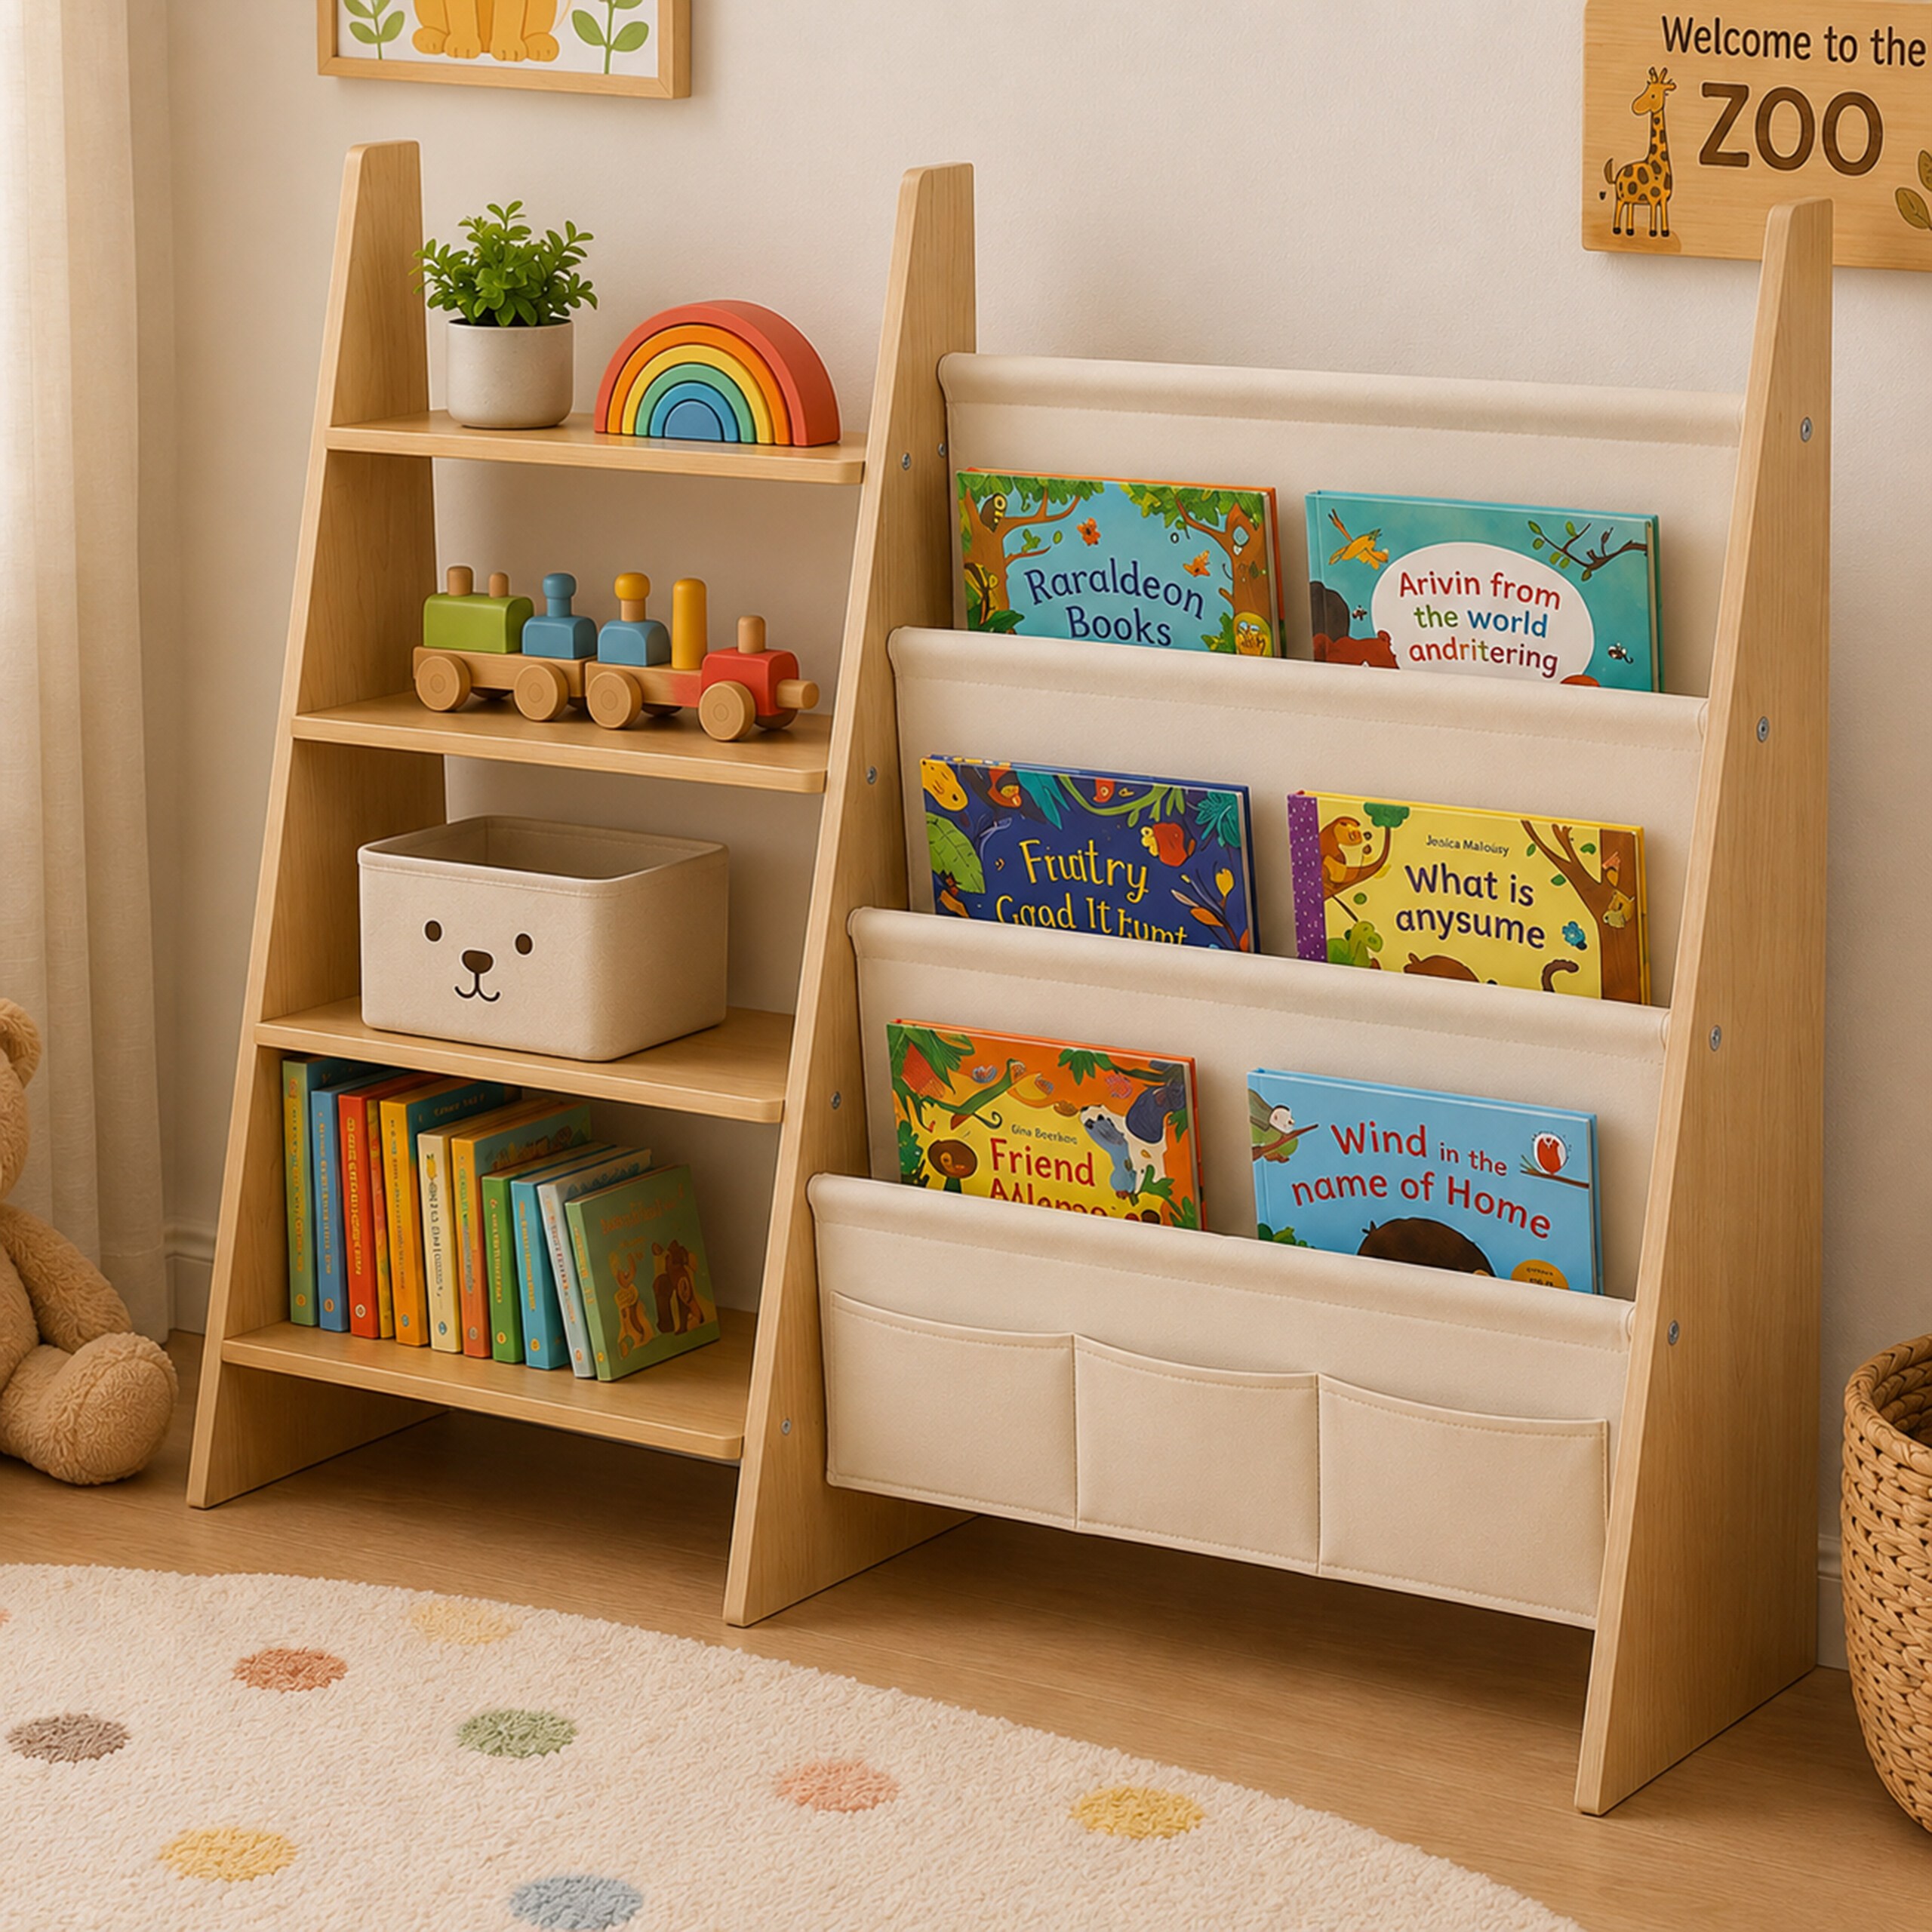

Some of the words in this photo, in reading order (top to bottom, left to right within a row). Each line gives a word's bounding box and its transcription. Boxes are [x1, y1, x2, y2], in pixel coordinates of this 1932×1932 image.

[1662, 15, 1811, 60] Welcome
[1823, 26, 1858, 63] to
[1870, 26, 1926, 66] the
[1699, 82, 1884, 177] ZOO
[1024, 558, 1204, 620] Raraldeon
[1399, 571, 1481, 598] Arivin
[1490, 571, 1561, 611] from
[1066, 605, 1172, 647] Books
[1414, 605, 1458, 628] the
[1467, 610, 1548, 638] world
[1408, 636, 1558, 678] andritering
[1404, 862, 1498, 900] What
[1510, 874, 1534, 906] is
[1395, 907, 1546, 949] anysume
[990, 1137, 1096, 1187] Friend
[1331, 1121, 1427, 1158] Wind
[1440, 1142, 1460, 1164] in
[1468, 1149, 1508, 1177] the
[1291, 1172, 1388, 1208] name
[1400, 1171, 1435, 1201] of
[1447, 1175, 1552, 1239] Home
